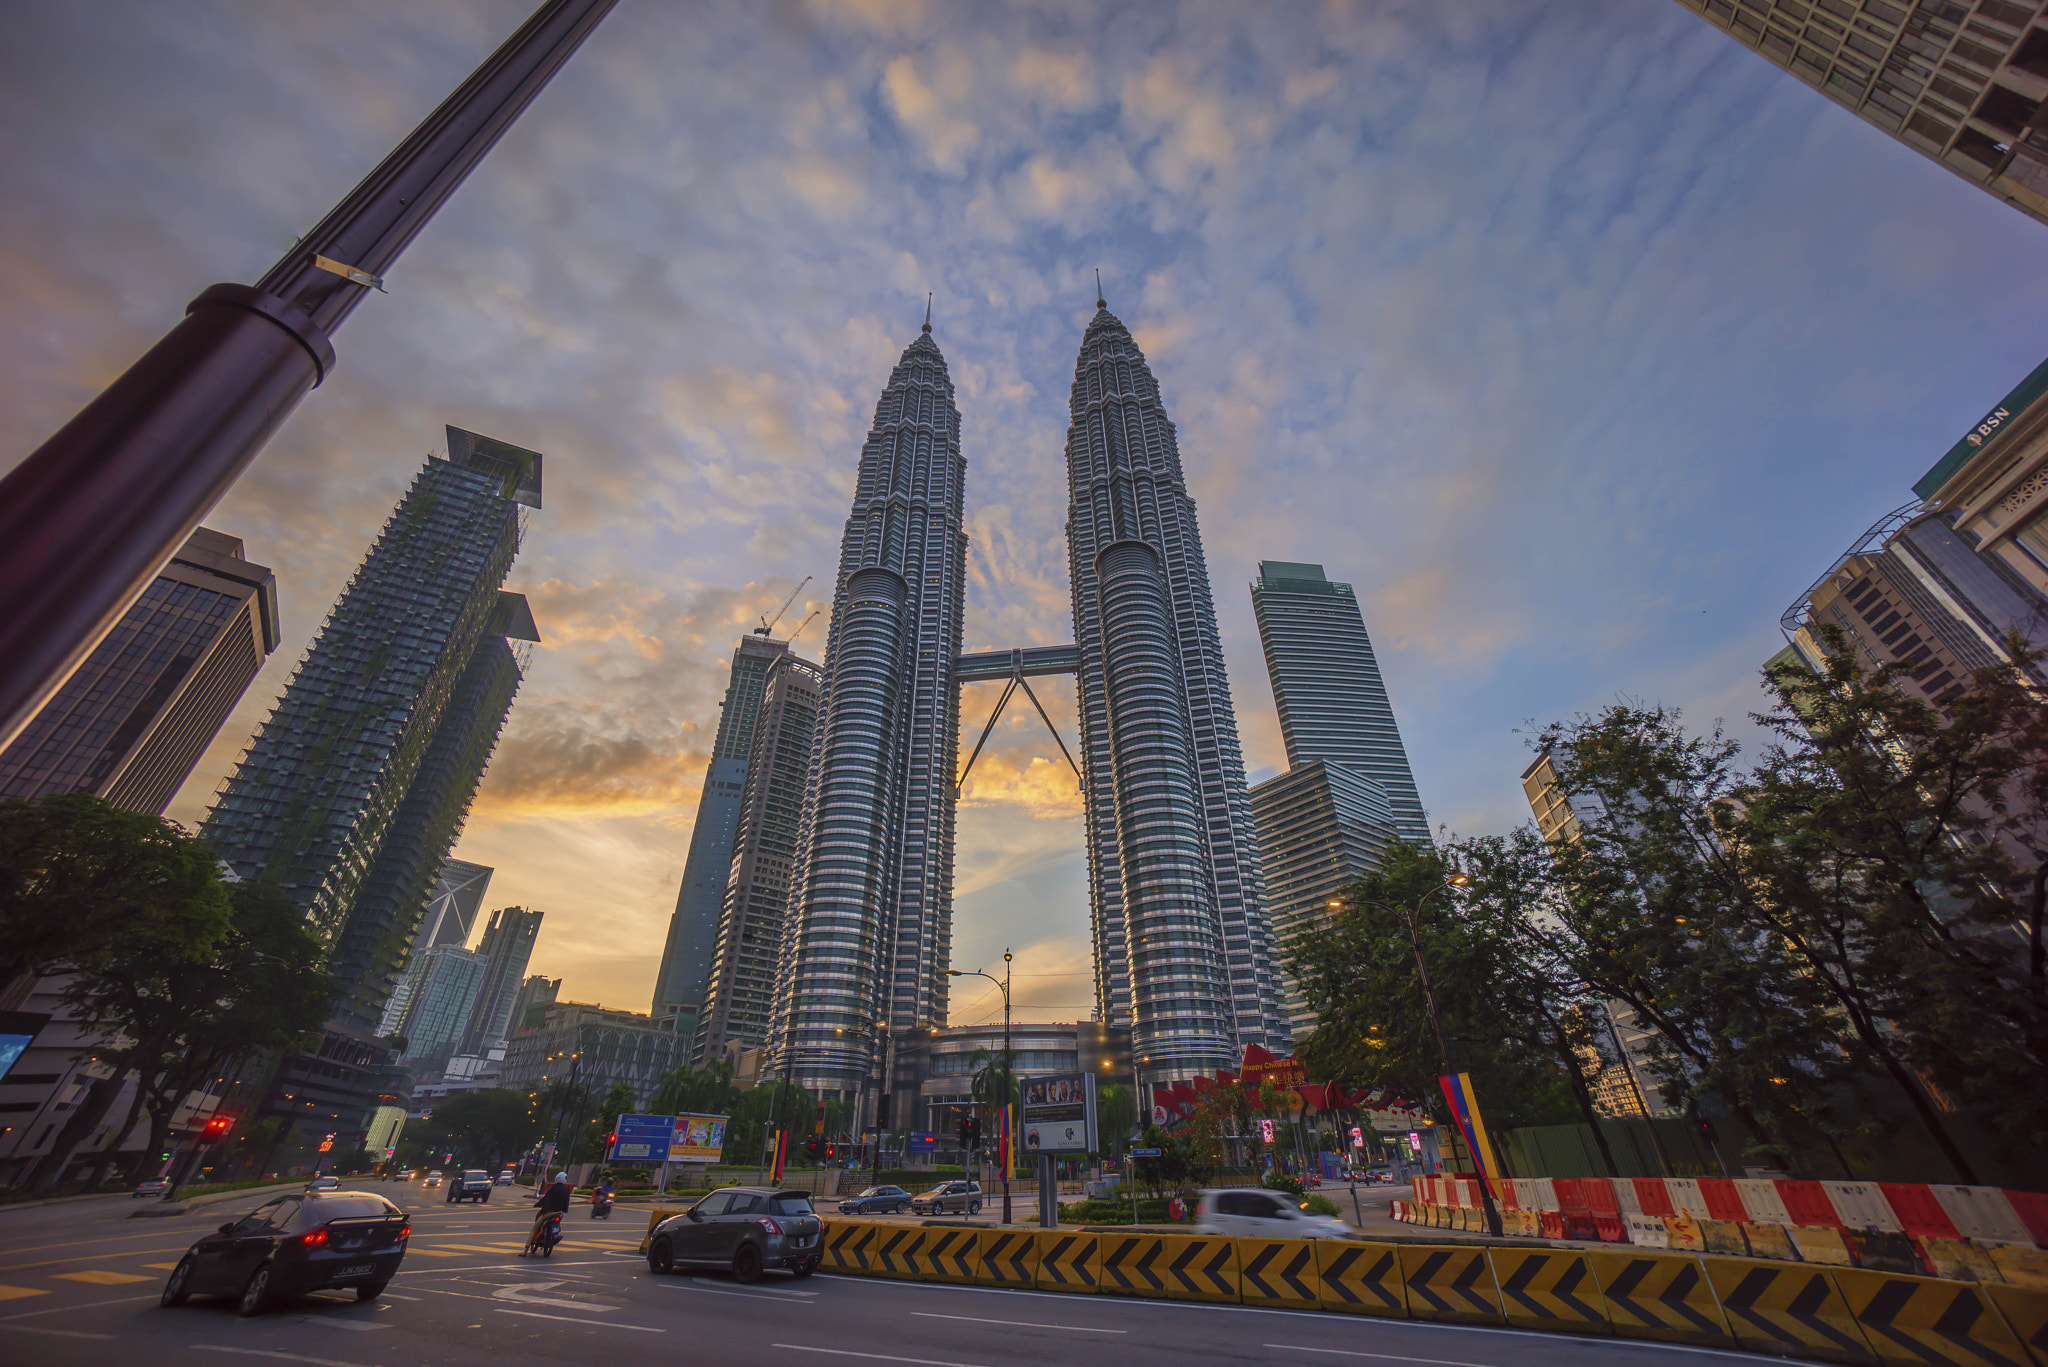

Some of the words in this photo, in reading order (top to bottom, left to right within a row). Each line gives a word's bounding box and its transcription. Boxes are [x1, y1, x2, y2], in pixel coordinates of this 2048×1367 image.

[1978, 407, 2010, 436] BSN
[1243, 1063, 1263, 1072] Happy
[1264, 1061, 1291, 1069] Chinese
